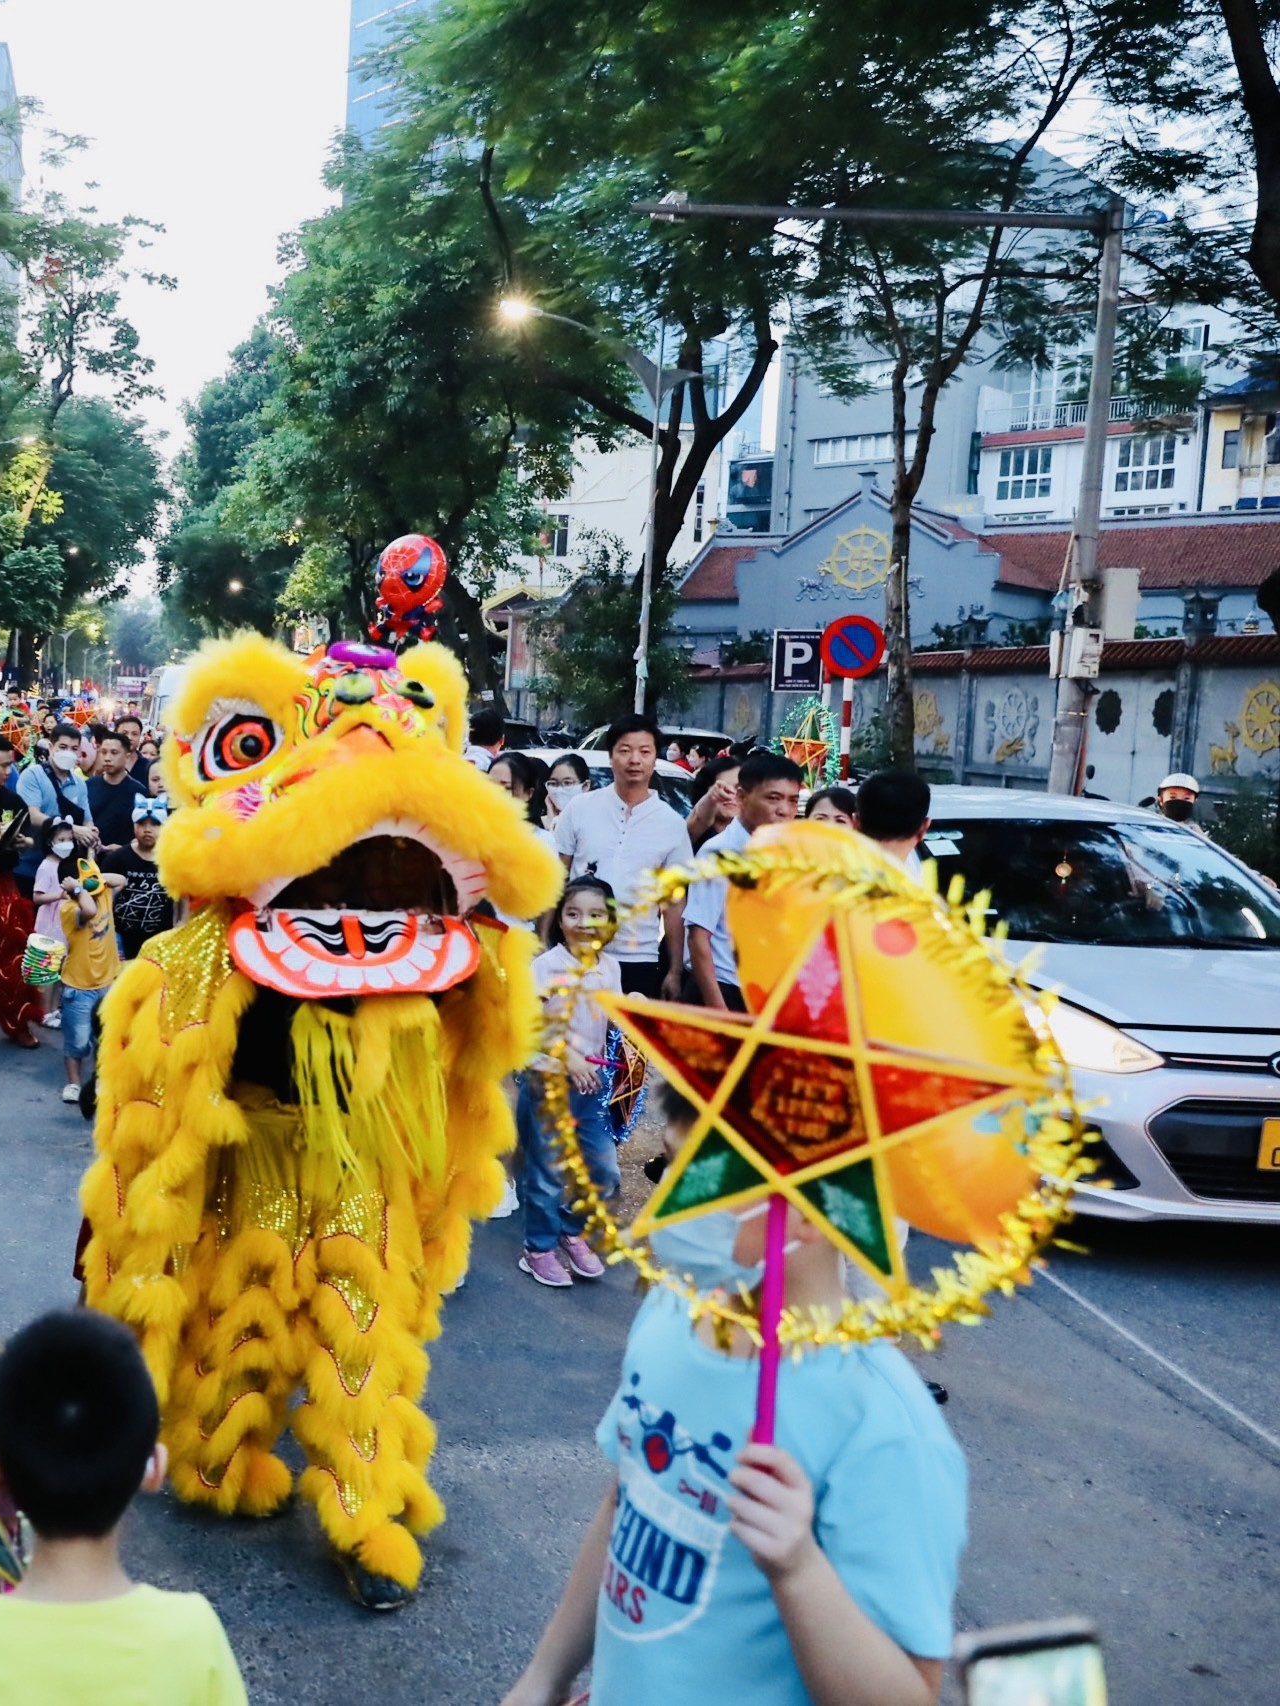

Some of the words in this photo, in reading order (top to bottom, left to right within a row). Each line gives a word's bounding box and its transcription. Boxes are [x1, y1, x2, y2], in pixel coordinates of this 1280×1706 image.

[784, 642, 813, 678] P
[127, 870, 146, 879] THINK
[613, 1499, 706, 1605] HIND
